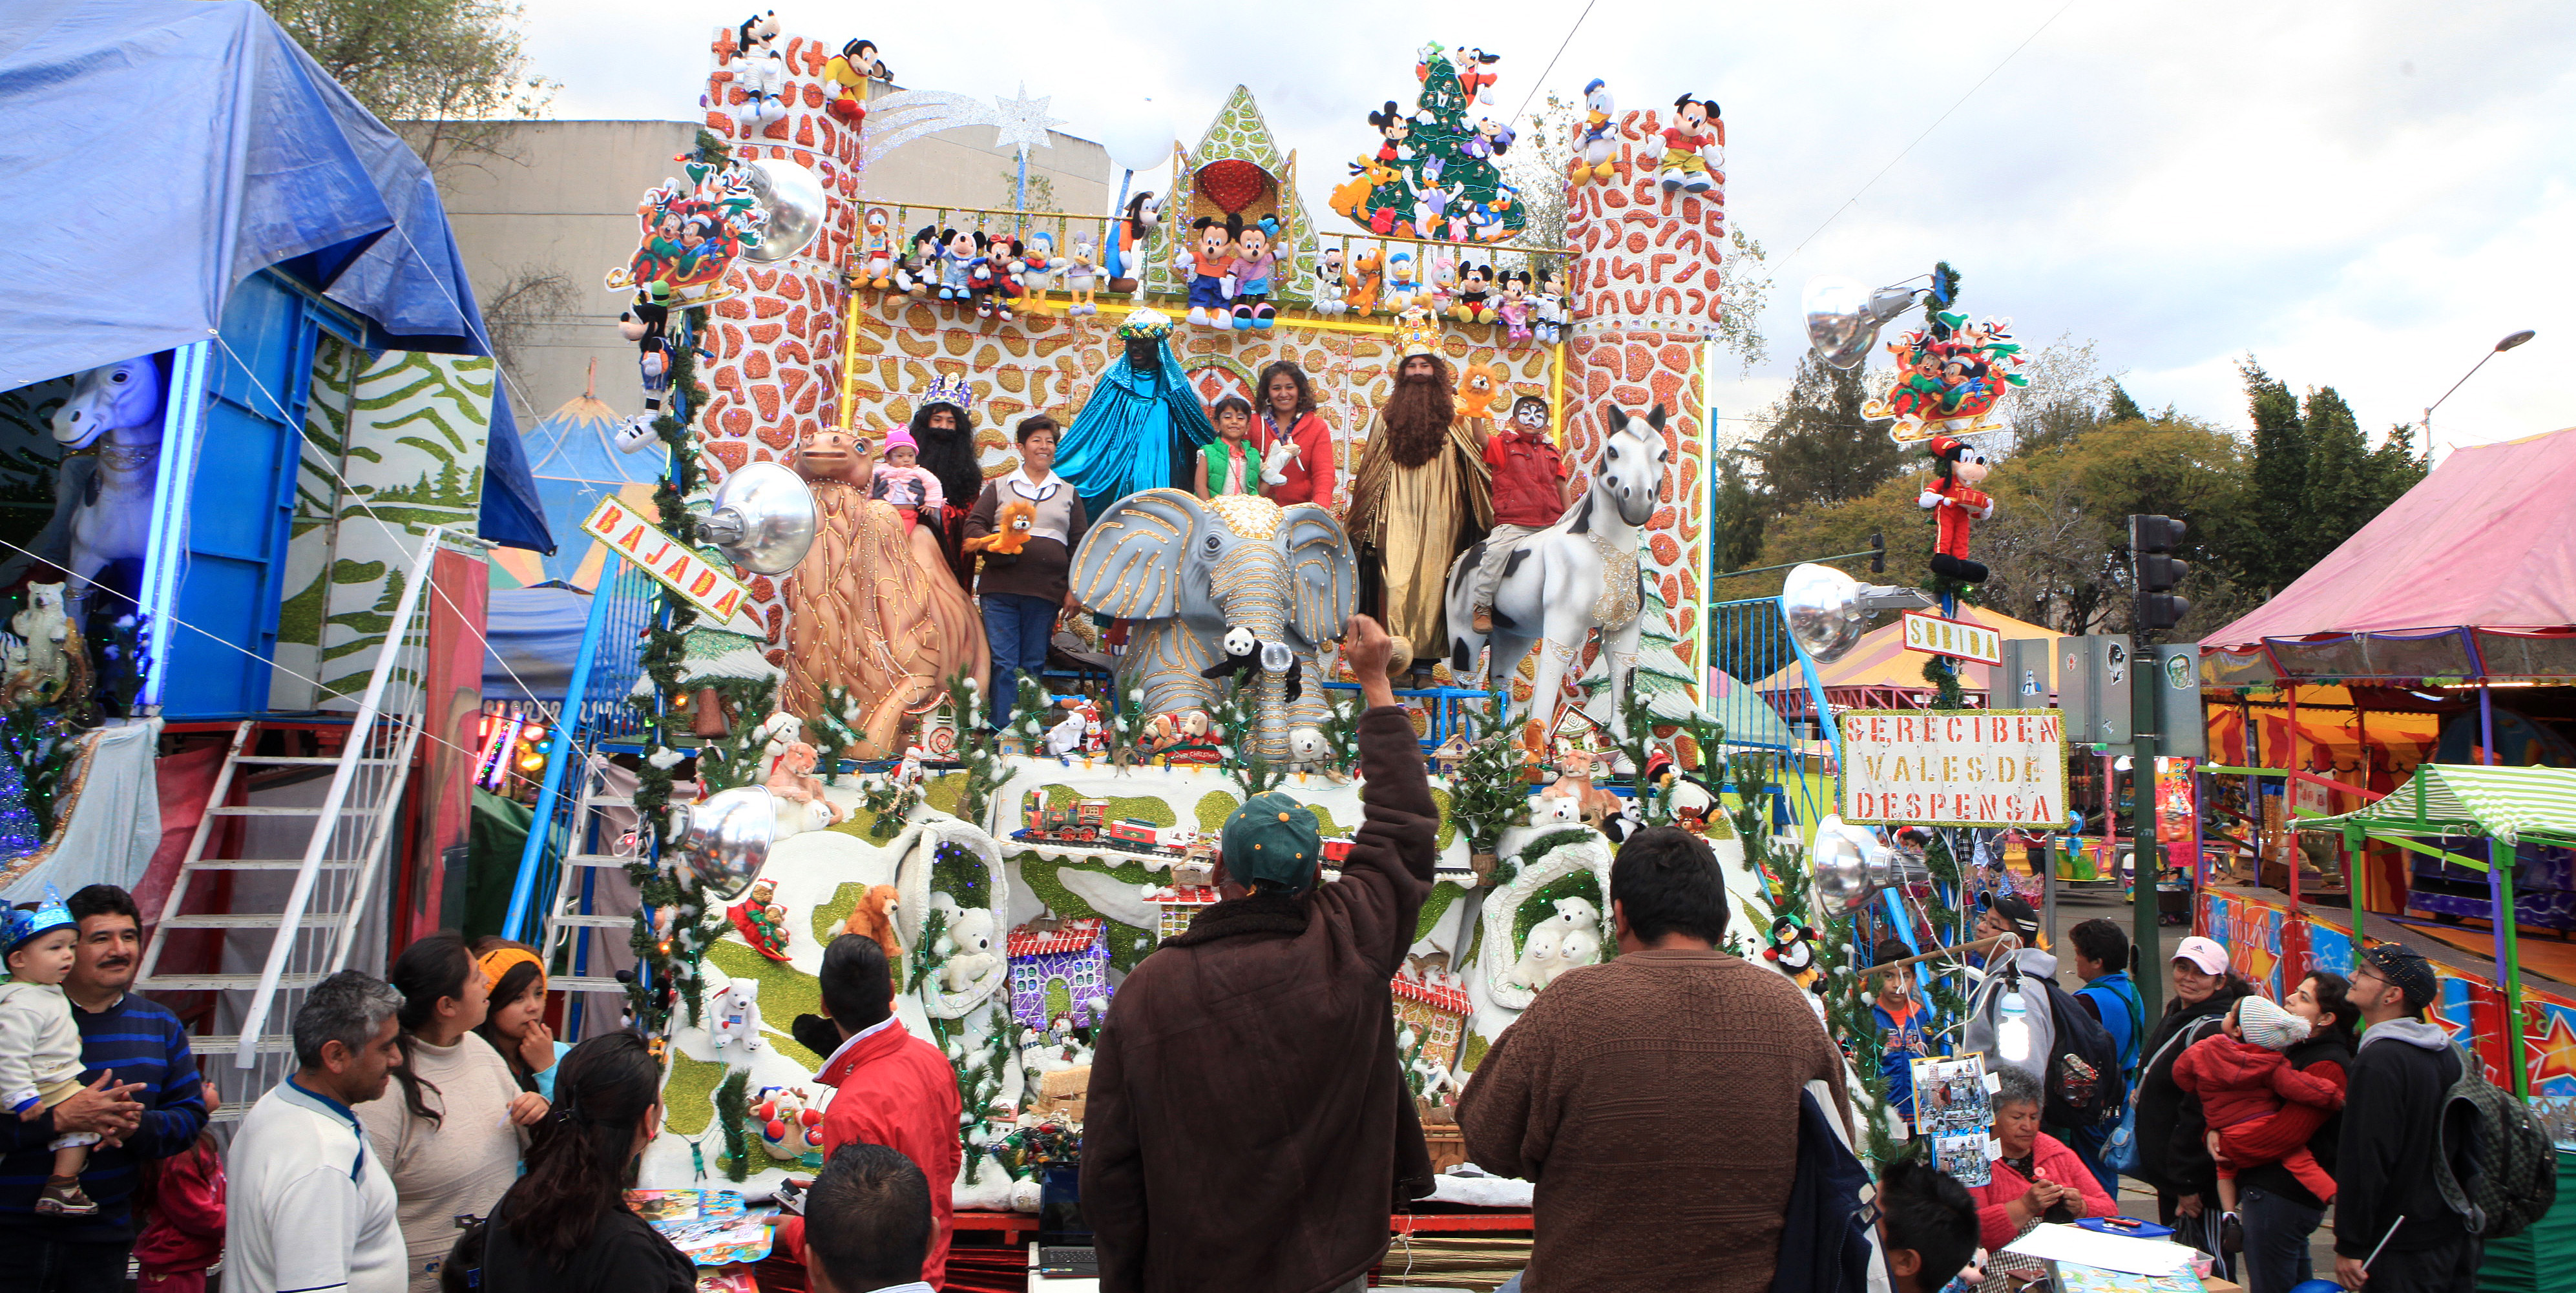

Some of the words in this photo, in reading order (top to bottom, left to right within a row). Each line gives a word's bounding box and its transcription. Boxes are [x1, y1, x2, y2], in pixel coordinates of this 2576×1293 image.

[594, 504, 740, 617] BAJADA
[1910, 618, 1997, 659] SUBIDA
[1896, 717, 2059, 743] RECIBEN
[1865, 755, 1983, 783] VALES
[1998, 756, 2041, 783] DE
[1856, 792, 2051, 822] DESPENSA
